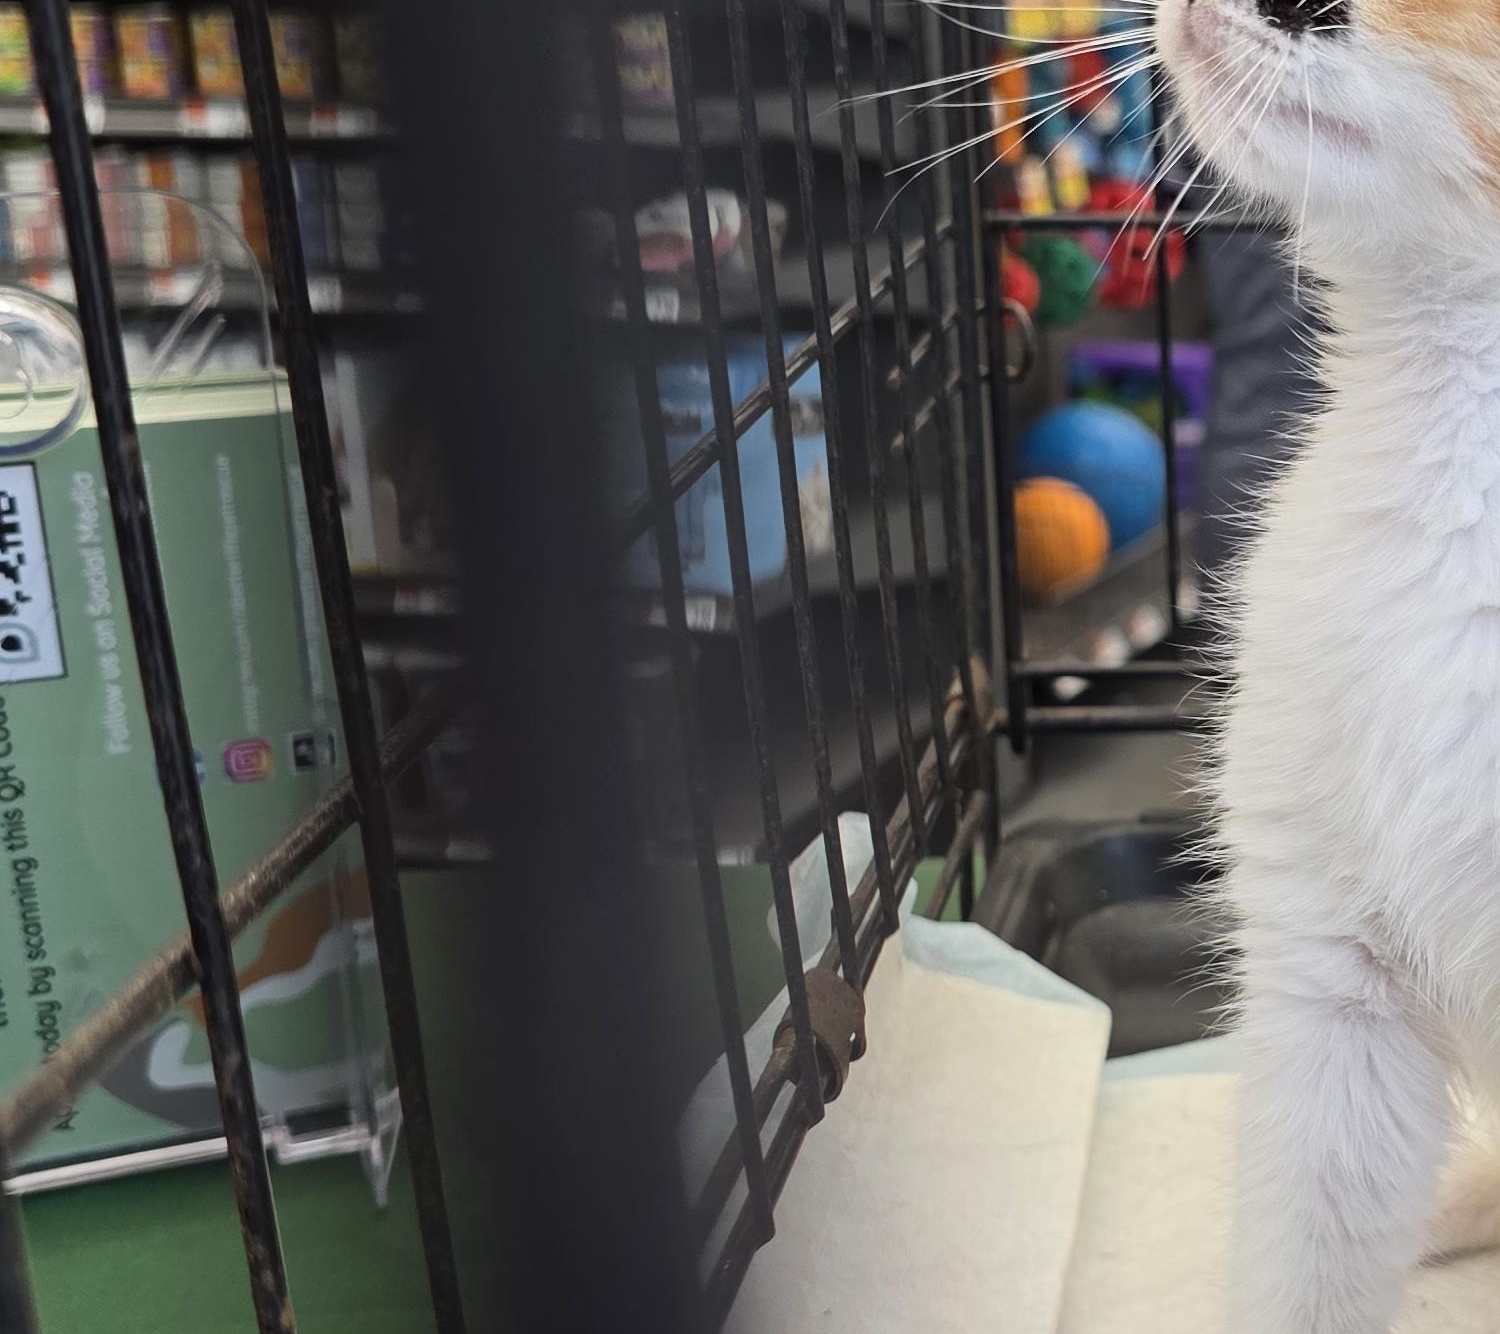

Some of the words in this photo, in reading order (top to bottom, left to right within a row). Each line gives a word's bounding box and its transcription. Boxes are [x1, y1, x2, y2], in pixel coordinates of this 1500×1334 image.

[71, 471, 100, 543] Media
[79, 546, 112, 617] Social
[96, 619, 117, 649] on
[100, 651, 121, 680] us
[104, 682, 131, 755] Follow
[0, 765, 26, 803] QR
[1, 808, 28, 852] this
[9, 857, 47, 961] scanning
[27, 964, 56, 998] by
[34, 998, 63, 1064] oday
